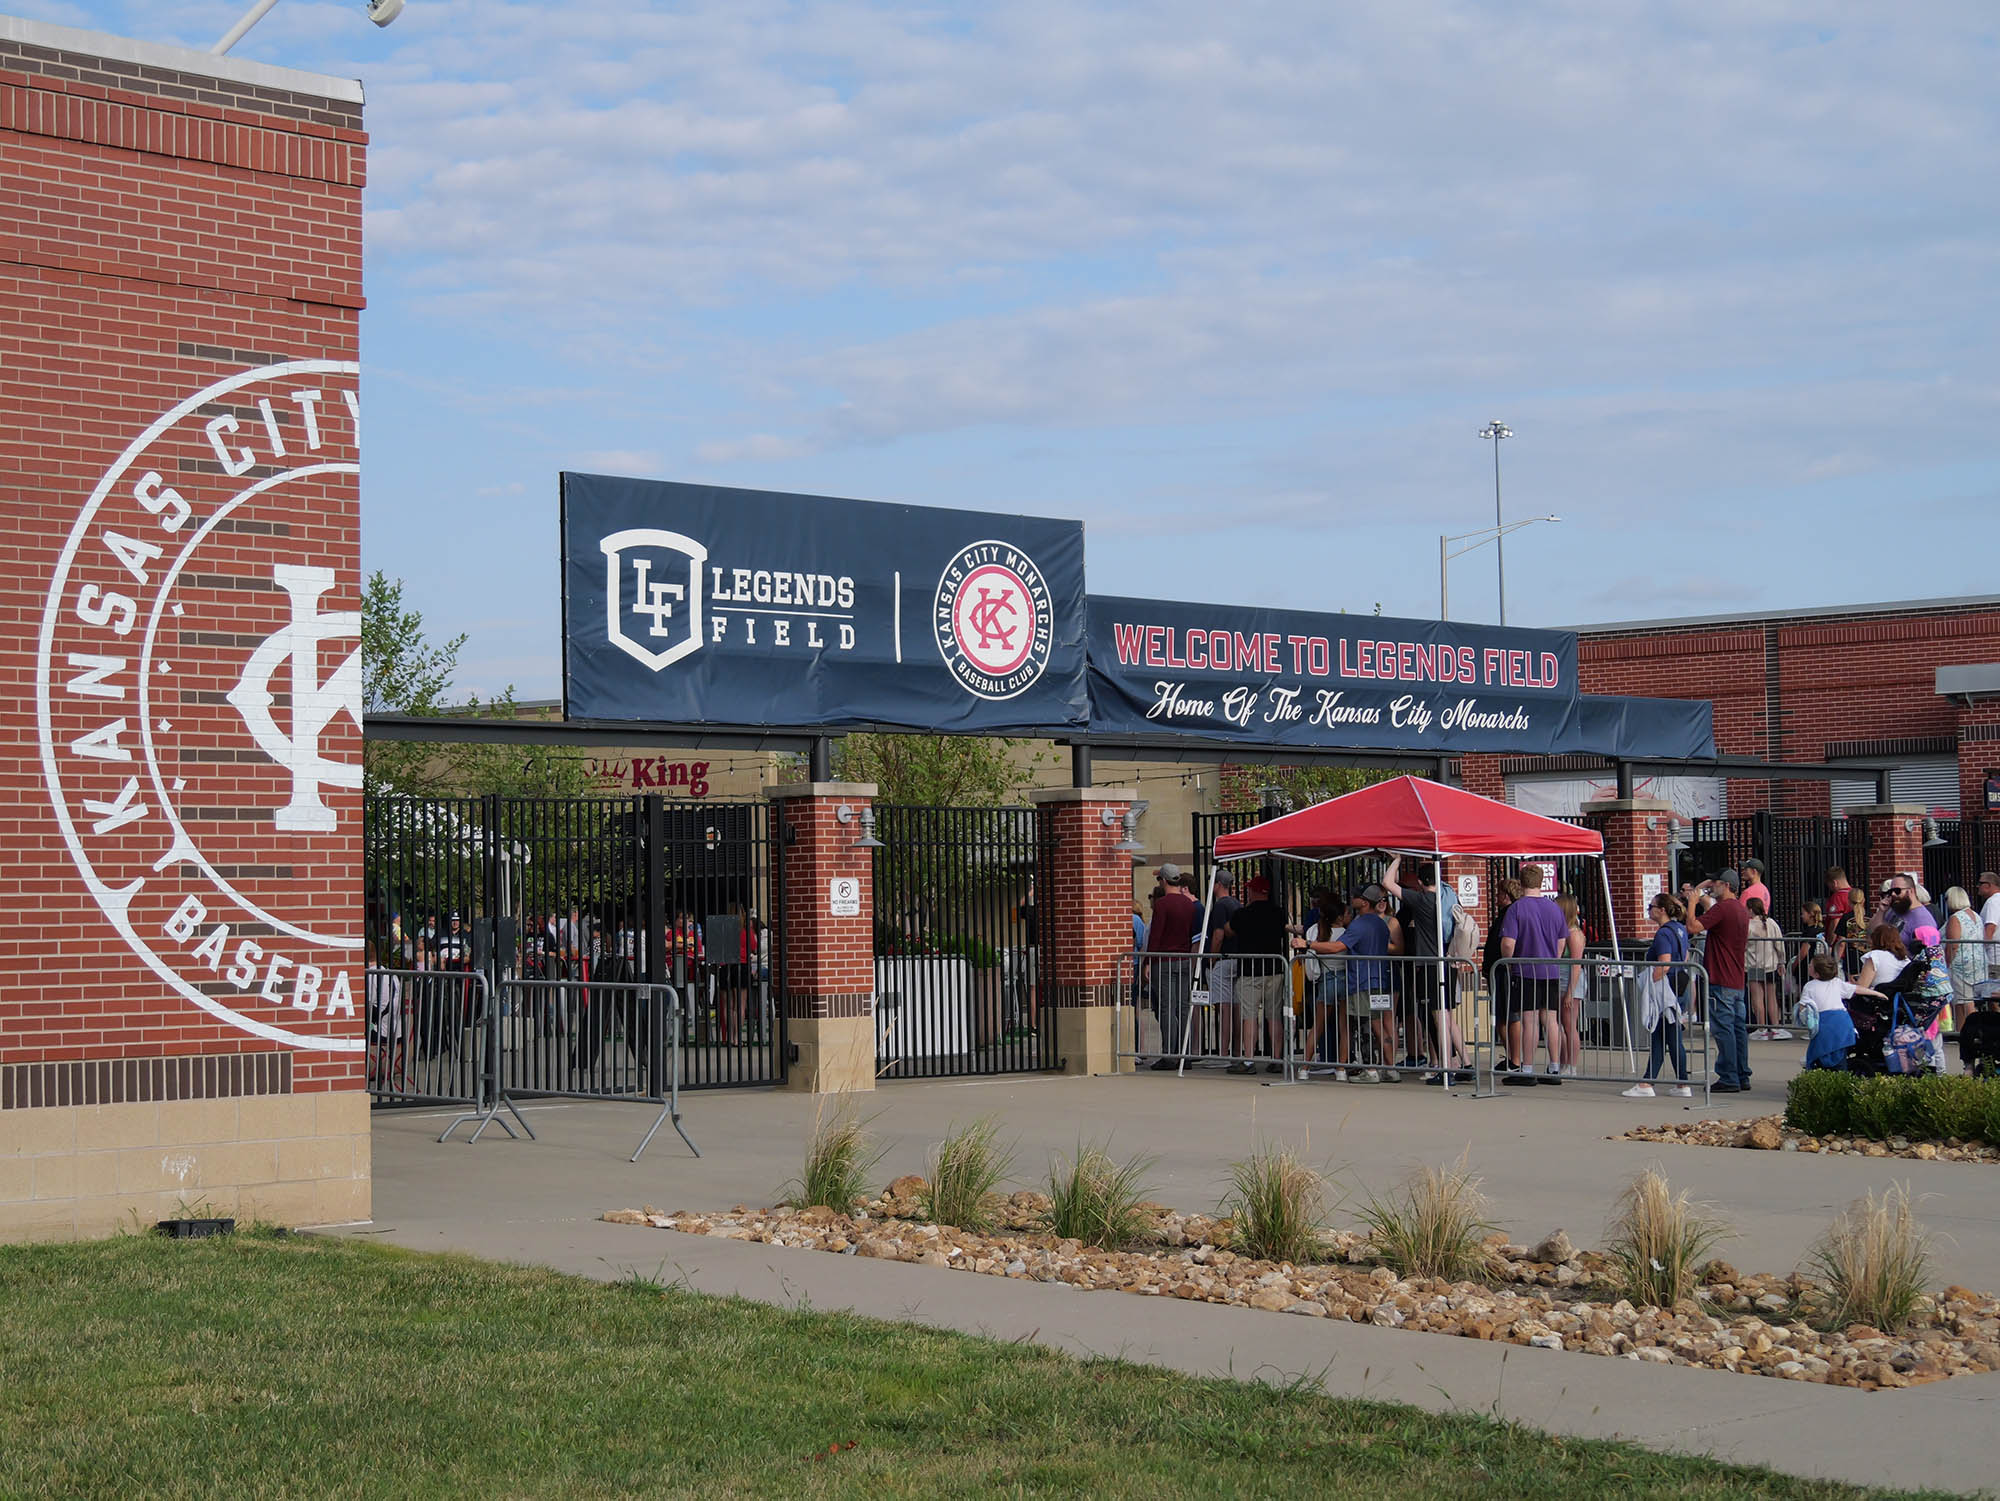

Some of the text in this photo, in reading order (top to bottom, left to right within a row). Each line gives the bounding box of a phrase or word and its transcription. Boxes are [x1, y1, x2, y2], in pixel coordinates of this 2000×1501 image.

[711, 566, 855, 609] LEGENDS
[938, 546, 1049, 654] KANSAS CITY MONARCHS
[66, 470, 192, 835] KANSAS
[711, 616, 855, 650] FIELD
[1113, 623, 1559, 689] WELCOME TO LEGENDS FIELD
[957, 661, 1034, 693] BASEBALL CLUB
[1146, 680, 1530, 734] Home Of The Kansas City Monarchs
[631, 755, 711, 797] King
